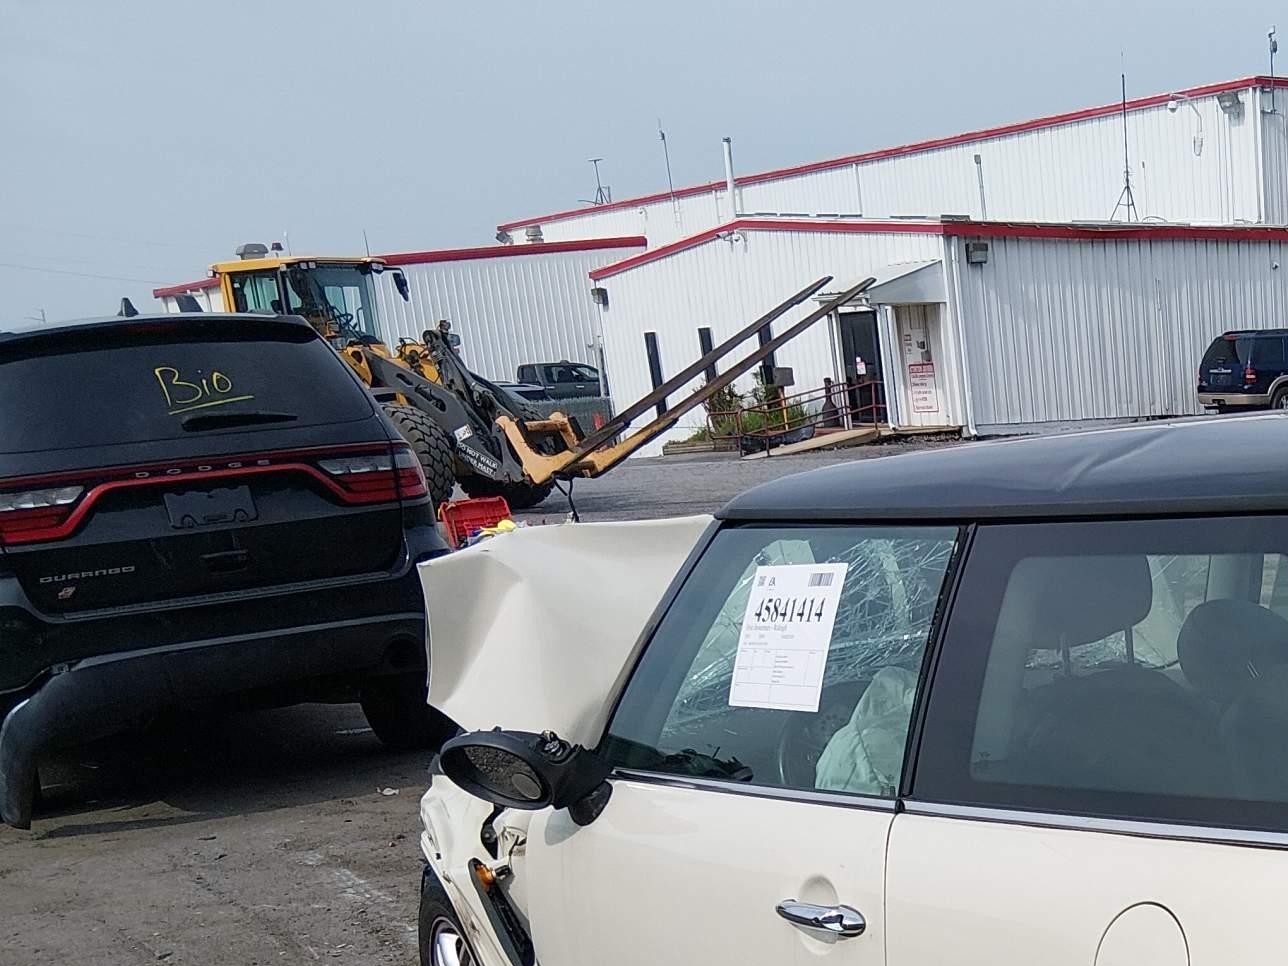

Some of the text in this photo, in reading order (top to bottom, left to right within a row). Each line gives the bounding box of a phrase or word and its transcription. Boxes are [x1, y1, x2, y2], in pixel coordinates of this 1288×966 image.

[135, 459, 270, 478] DODGE
[480, 455, 498, 469] WALK
[39, 565, 136, 583] DURANGO
[754, 597, 826, 623] 45841414
